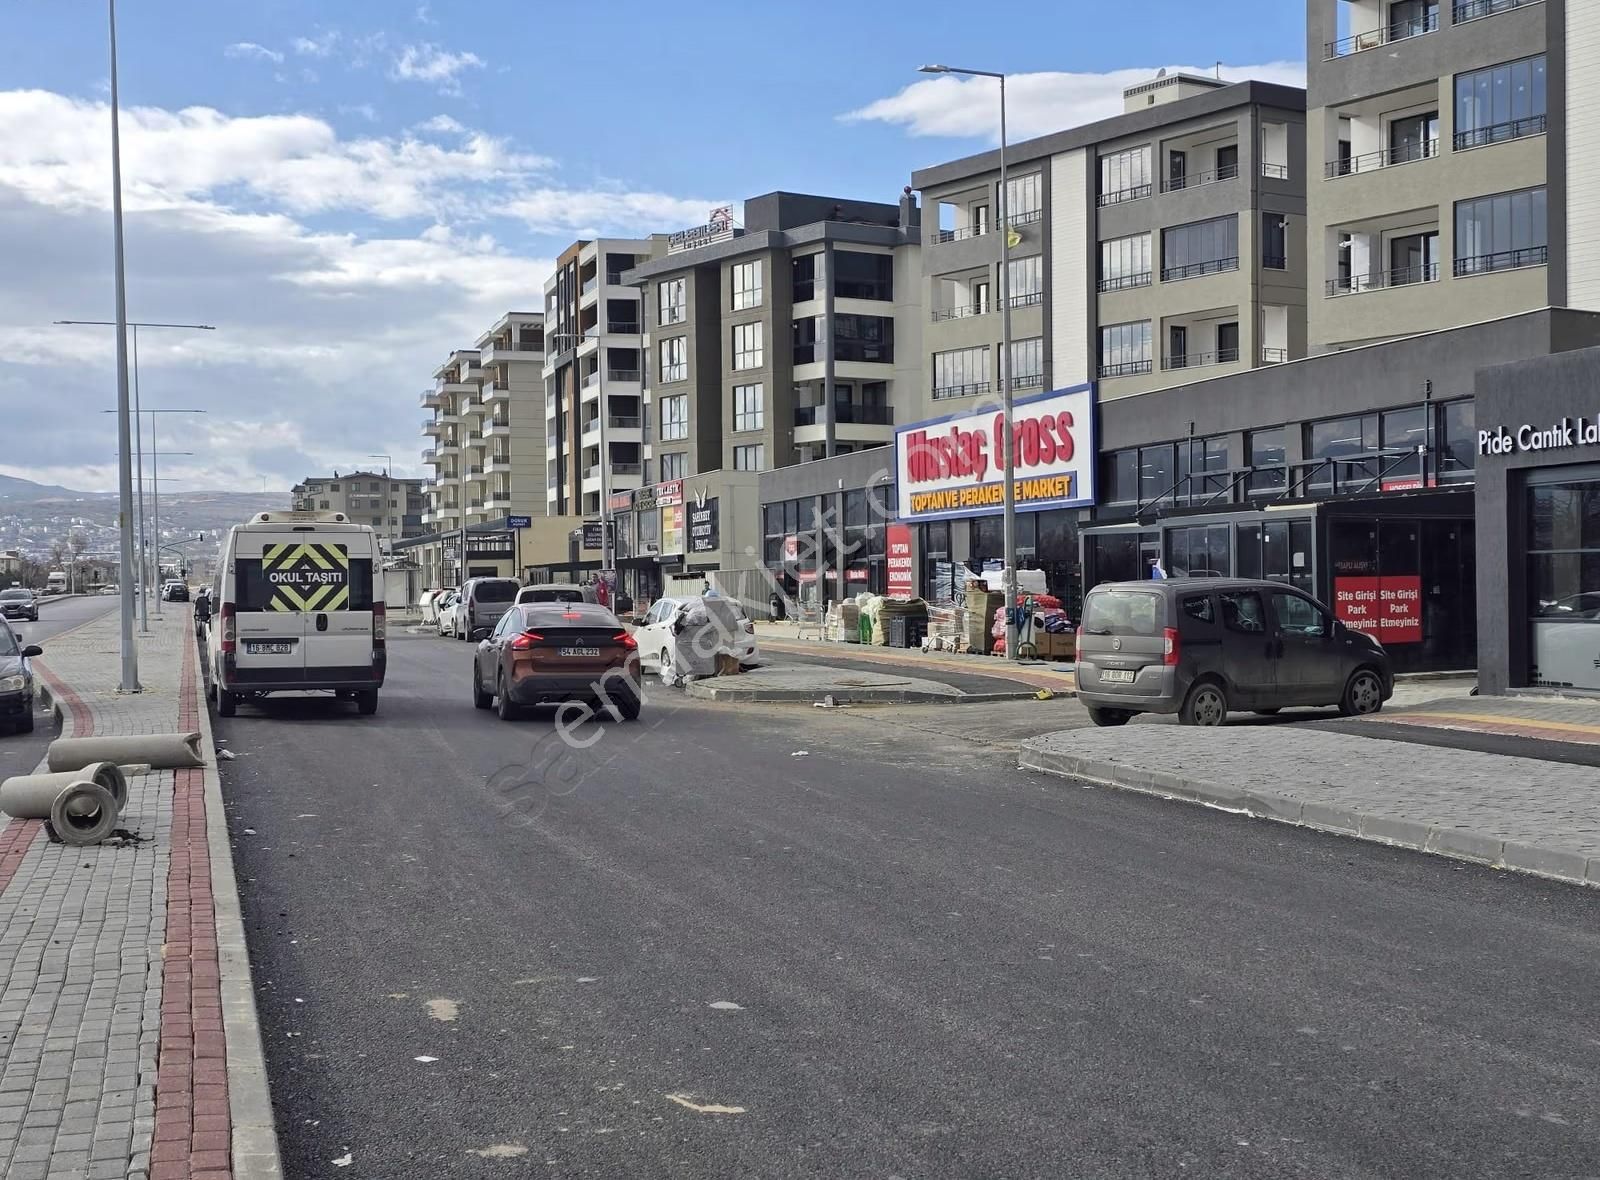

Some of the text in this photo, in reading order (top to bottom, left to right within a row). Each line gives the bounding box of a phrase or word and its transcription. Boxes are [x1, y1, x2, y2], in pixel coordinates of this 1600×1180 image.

[1478, 426, 1513, 455] Pide
[1517, 417, 1573, 451] Cantık
[907, 426, 988, 483] Mustaç
[911, 475, 1072, 512] TOPTAN VE PERAKENE MARKET
[269, 572, 342, 585] OKUL TAŞITI
[1337, 590, 1377, 602] Site Girişi
[1380, 588, 1418, 600] Site Girişi
[1347, 604, 1367, 614] Park
[1390, 603, 1409, 613] Park
[1380, 617, 1419, 628] Etmeyiniz
